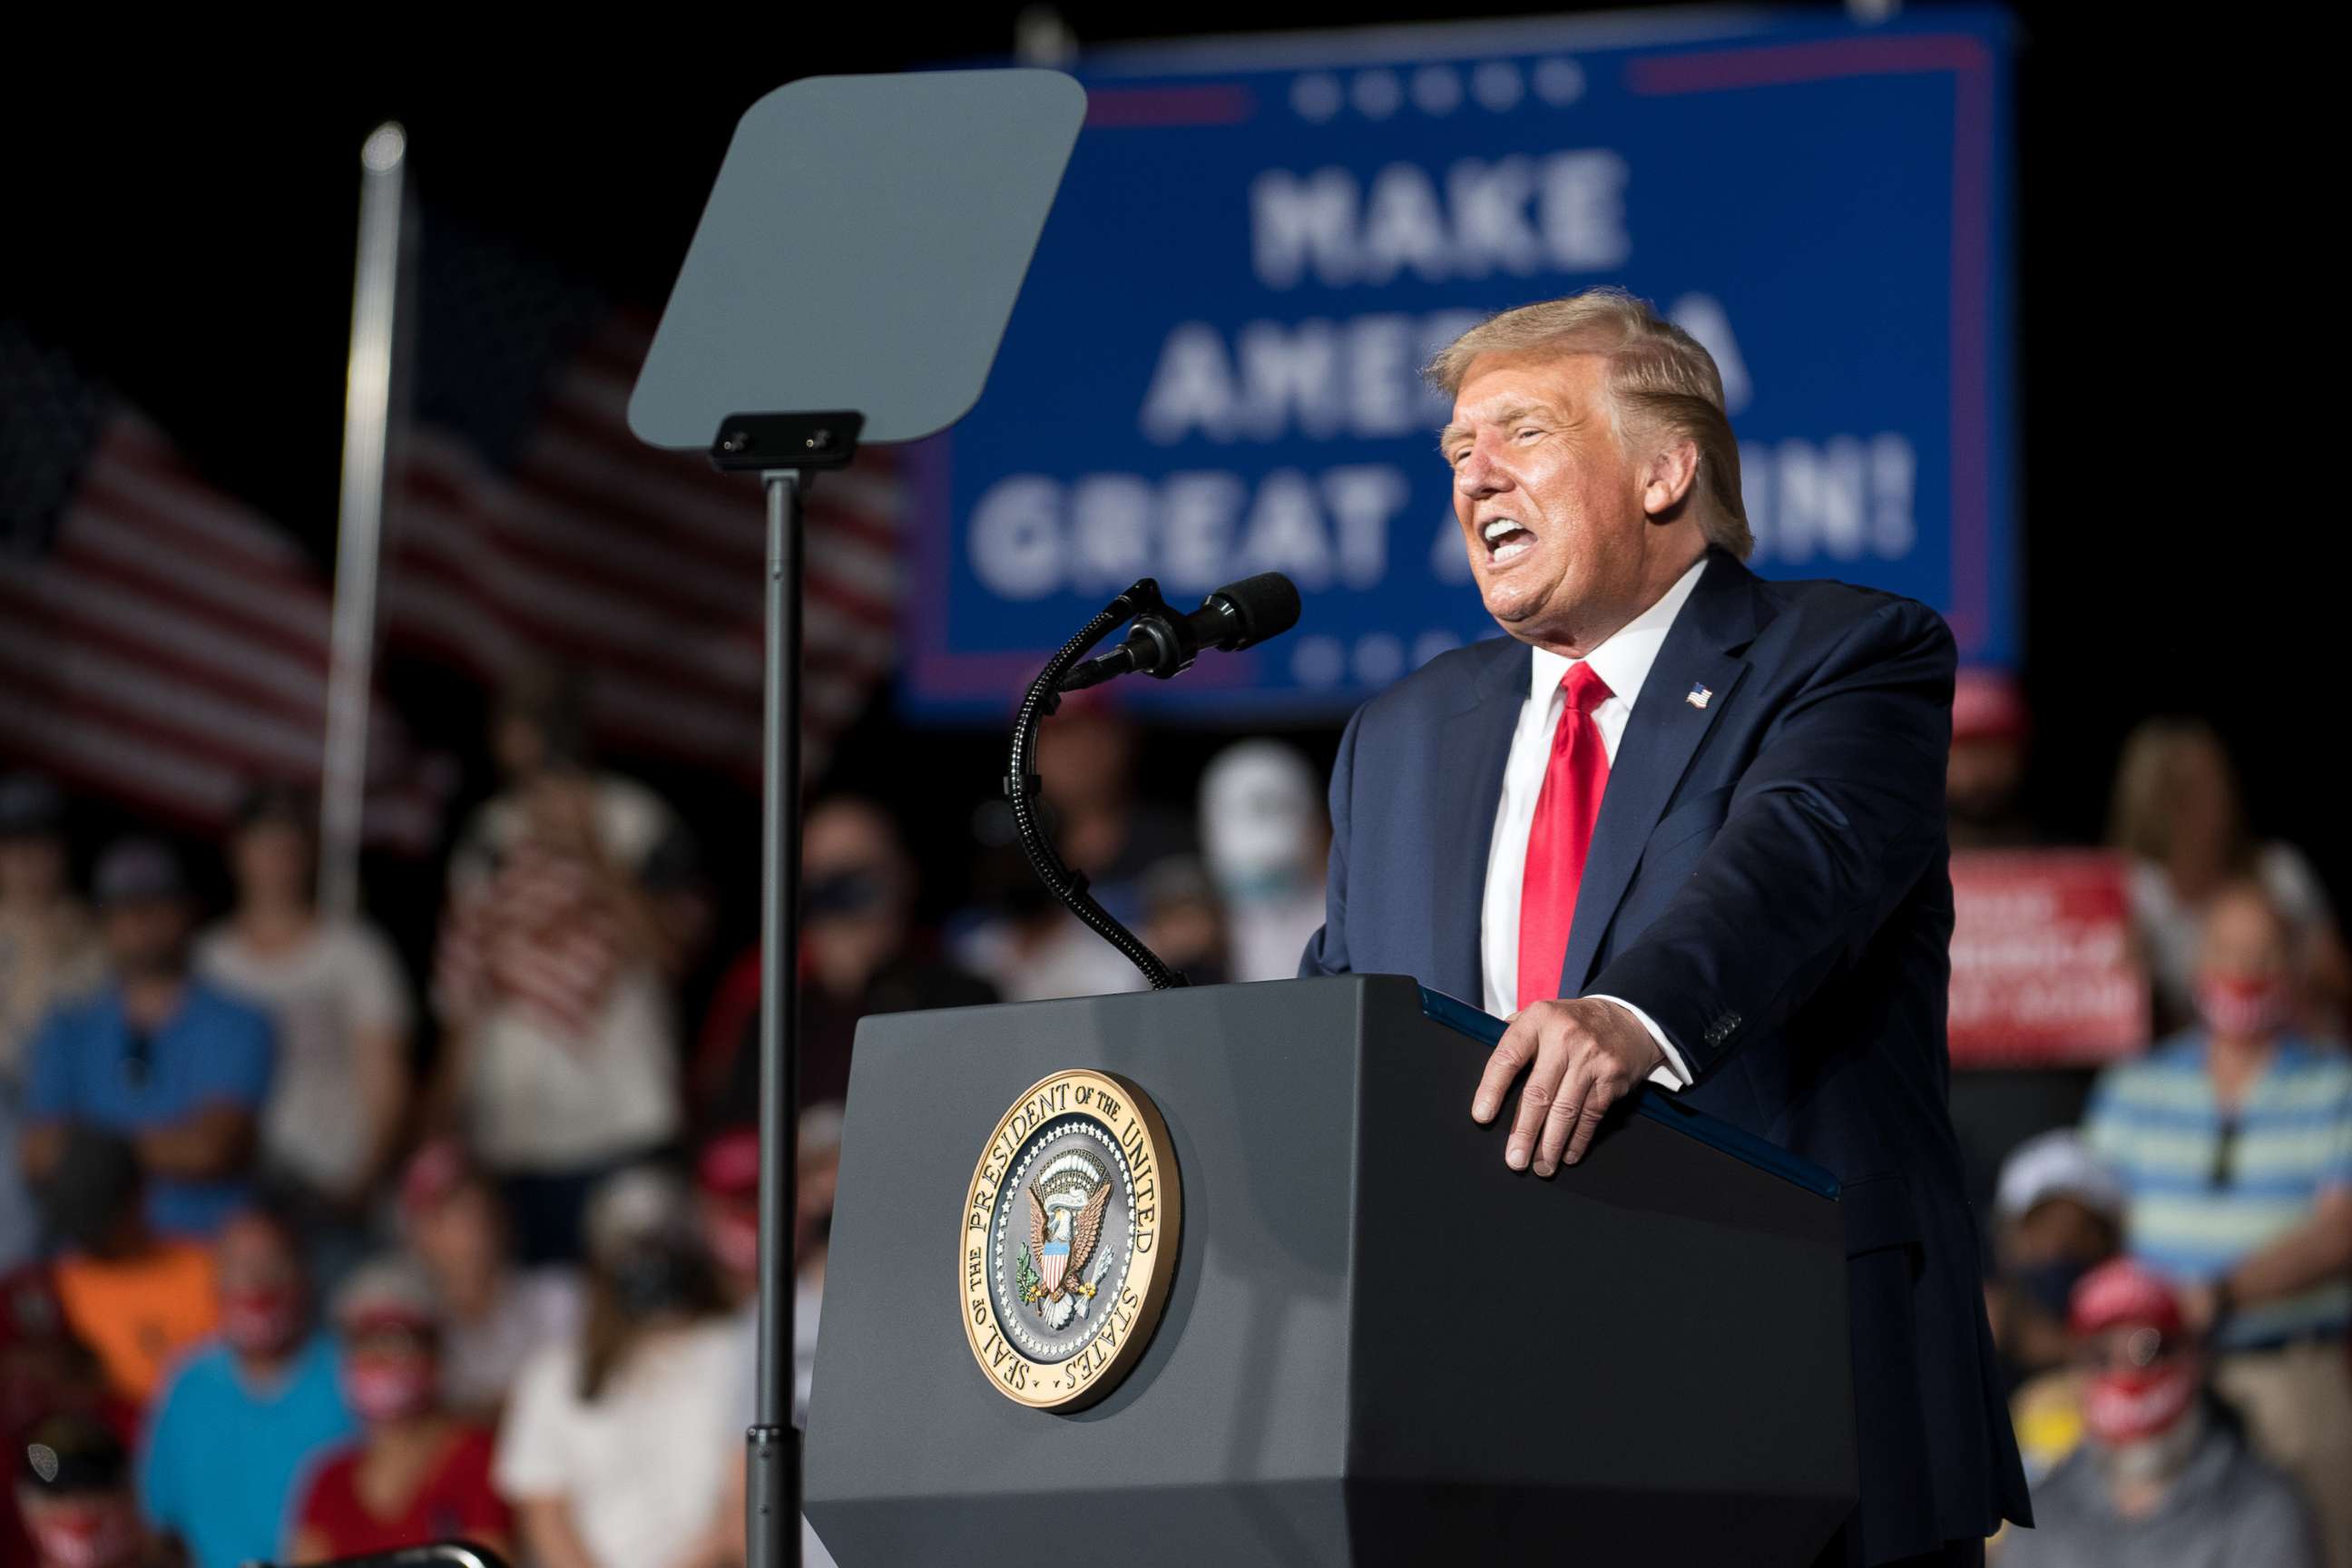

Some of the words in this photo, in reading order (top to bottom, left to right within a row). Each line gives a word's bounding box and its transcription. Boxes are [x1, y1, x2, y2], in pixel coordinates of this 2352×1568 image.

[1254, 151, 1629, 285] MAKE
[971, 466, 1408, 597] GREAT
[1075, 1085, 1094, 1105] OF
[1097, 1092, 1121, 1122] THE
[970, 1083, 1069, 1232] PRESIDENT
[1122, 1118, 1155, 1253] UNITED
[969, 1247, 981, 1292] THE
[972, 1298, 987, 1326] OF
[1065, 1286, 1139, 1389] STATES
[984, 1325, 1029, 1390] SEAL
